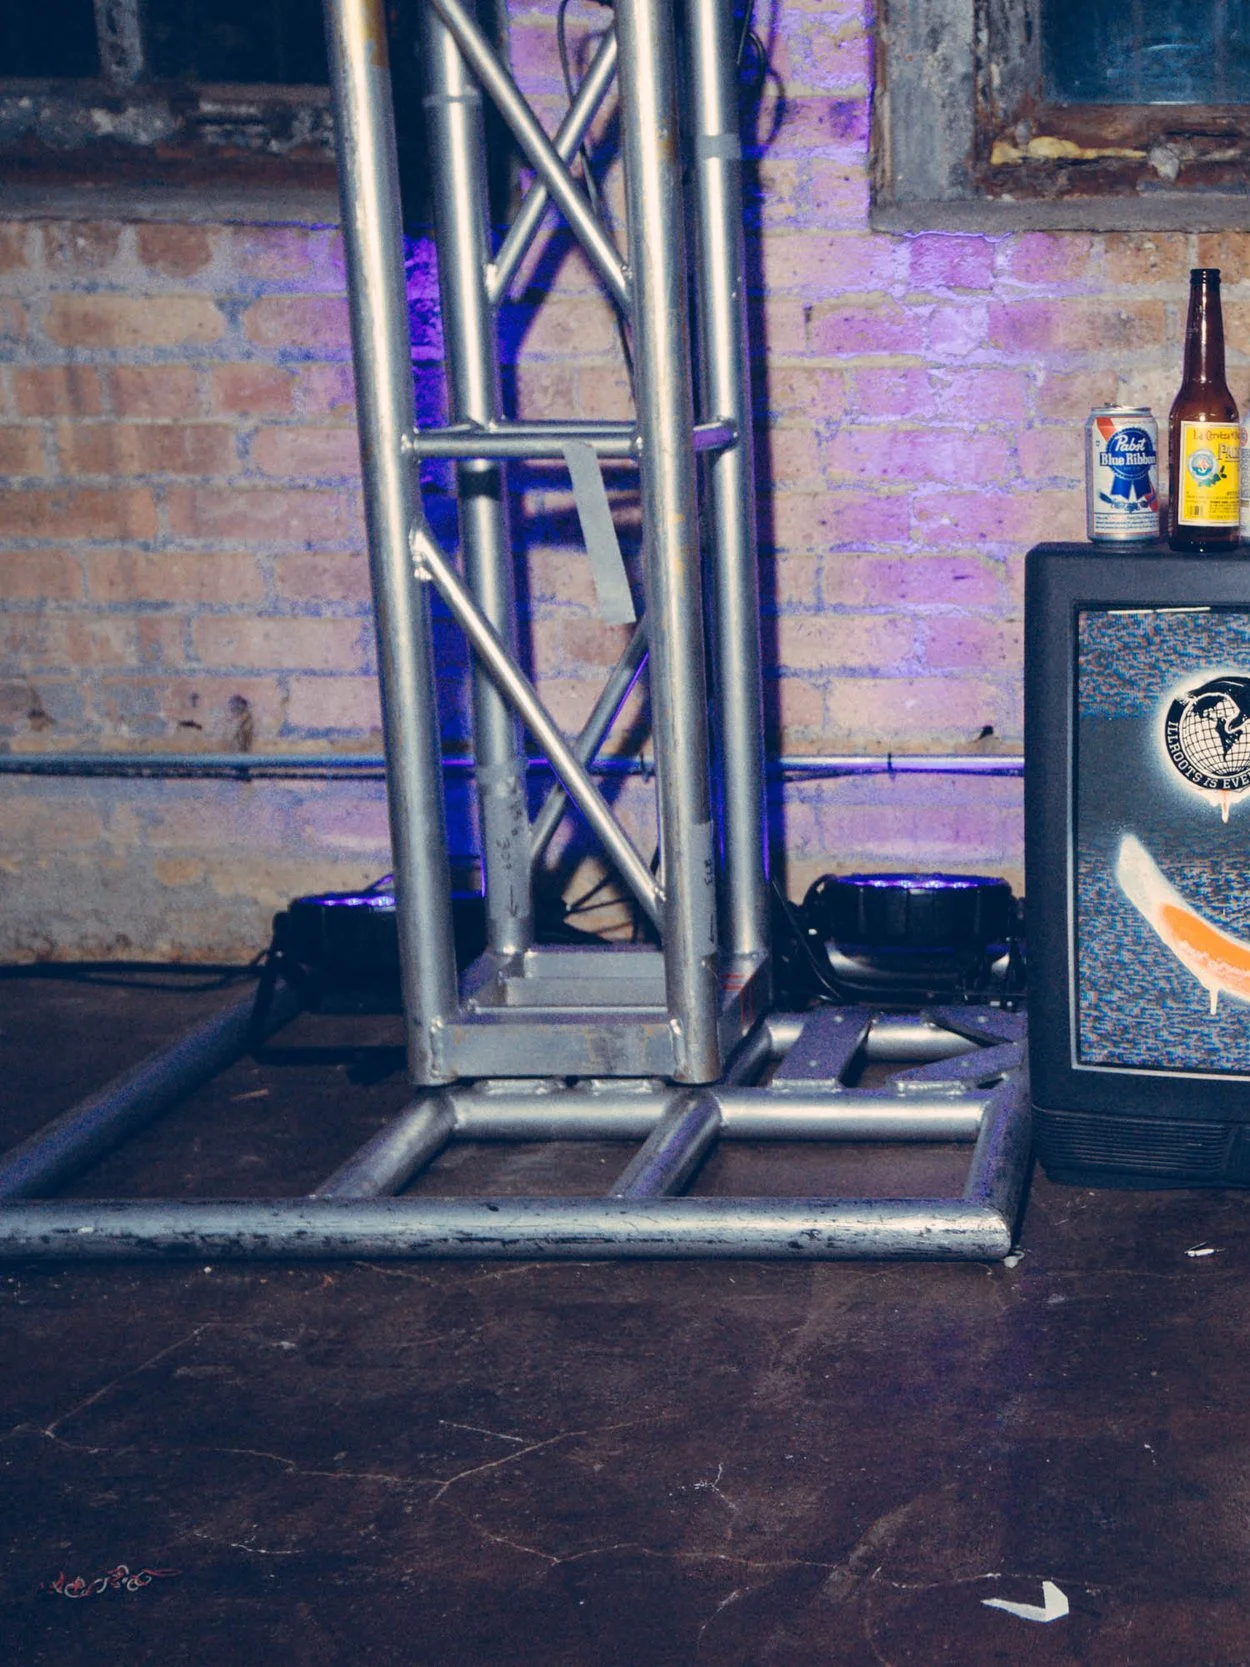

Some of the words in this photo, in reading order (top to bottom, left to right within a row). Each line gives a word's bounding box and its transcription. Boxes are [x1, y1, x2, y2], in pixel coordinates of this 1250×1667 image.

[1114, 434, 1146, 451] Pabst
[1101, 452, 1125, 465] Blue
[1167, 720, 1203, 783] ILLROOTS
[1203, 779, 1219, 789] IS
